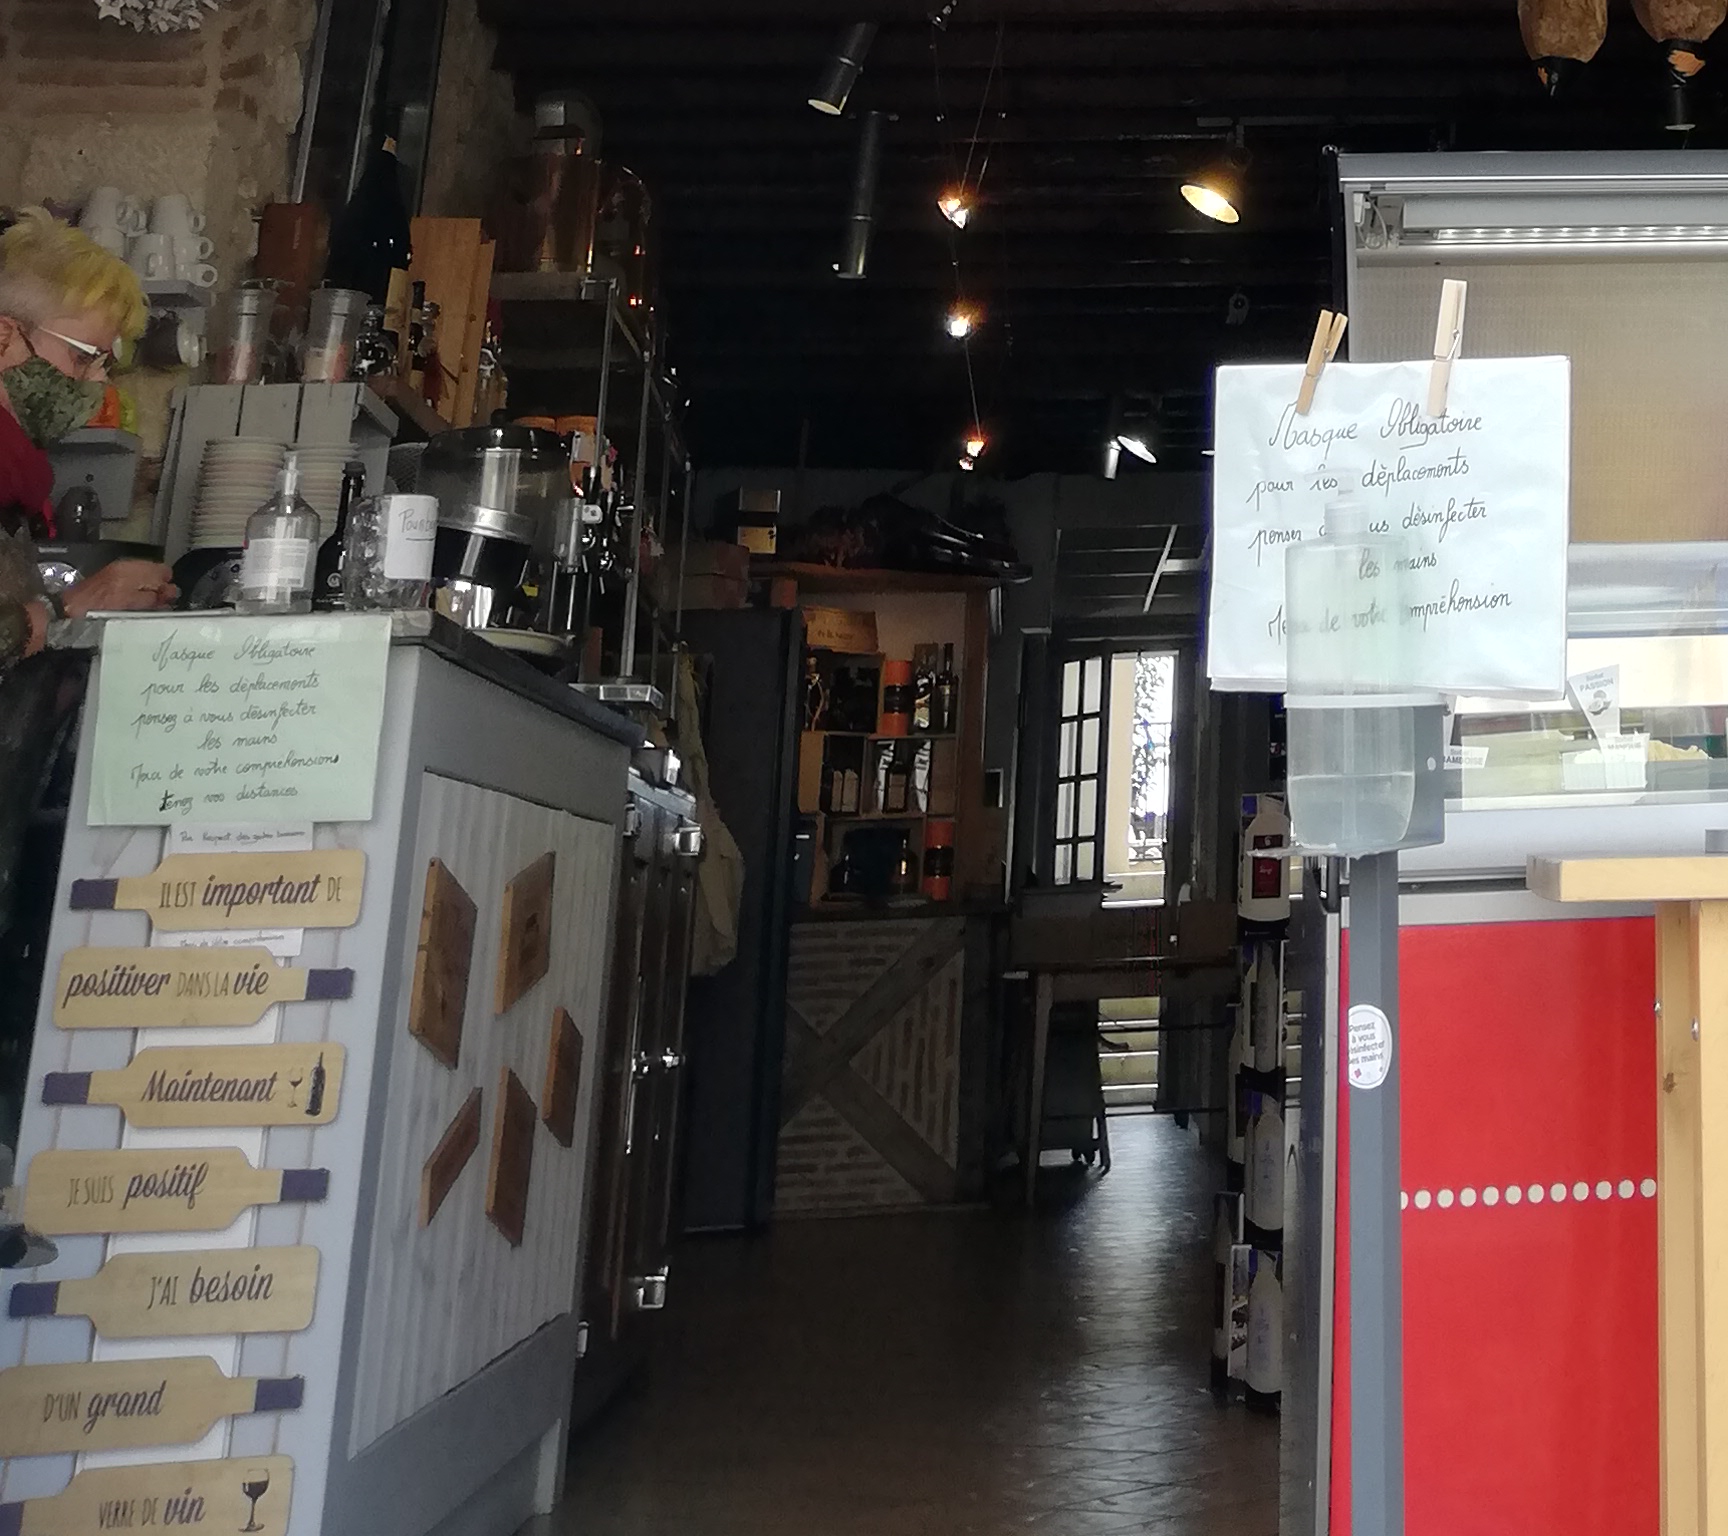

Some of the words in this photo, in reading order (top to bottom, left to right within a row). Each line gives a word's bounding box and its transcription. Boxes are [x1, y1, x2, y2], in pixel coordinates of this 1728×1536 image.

[1246, 479, 1294, 511] pour
[234, 634, 316, 666] Obligatoire
[140, 683, 185, 706] pour
[195, 673, 220, 693] les
[1579, 677, 1614, 692] PASSION
[200, 714, 234, 724] vous
[198, 730, 222, 751] les
[232, 733, 278, 747] mains
[169, 764, 184, 779] de
[194, 758, 228, 776] votre
[204, 792, 225, 803] vos
[236, 783, 298, 801] distances
[159, 882, 171, 908] IL
[174, 881, 197, 908] EST
[201, 874, 322, 918] important
[326, 877, 343, 902] DE
[62, 964, 171, 1009] positiver
[176, 972, 212, 998] DANS
[213, 971, 231, 997] LA
[233, 963, 270, 996] vie
[140, 1071, 278, 1103] Maintenant
[67, 1178, 83, 1207] JE
[84, 1175, 114, 1205] SUIS
[122, 1161, 209, 1210] positif
[189, 1264, 274, 1304] besoin
[83, 1381, 167, 1433] grand
[141, 1496, 159, 1526] DE
[163, 1487, 207, 1526] vin
